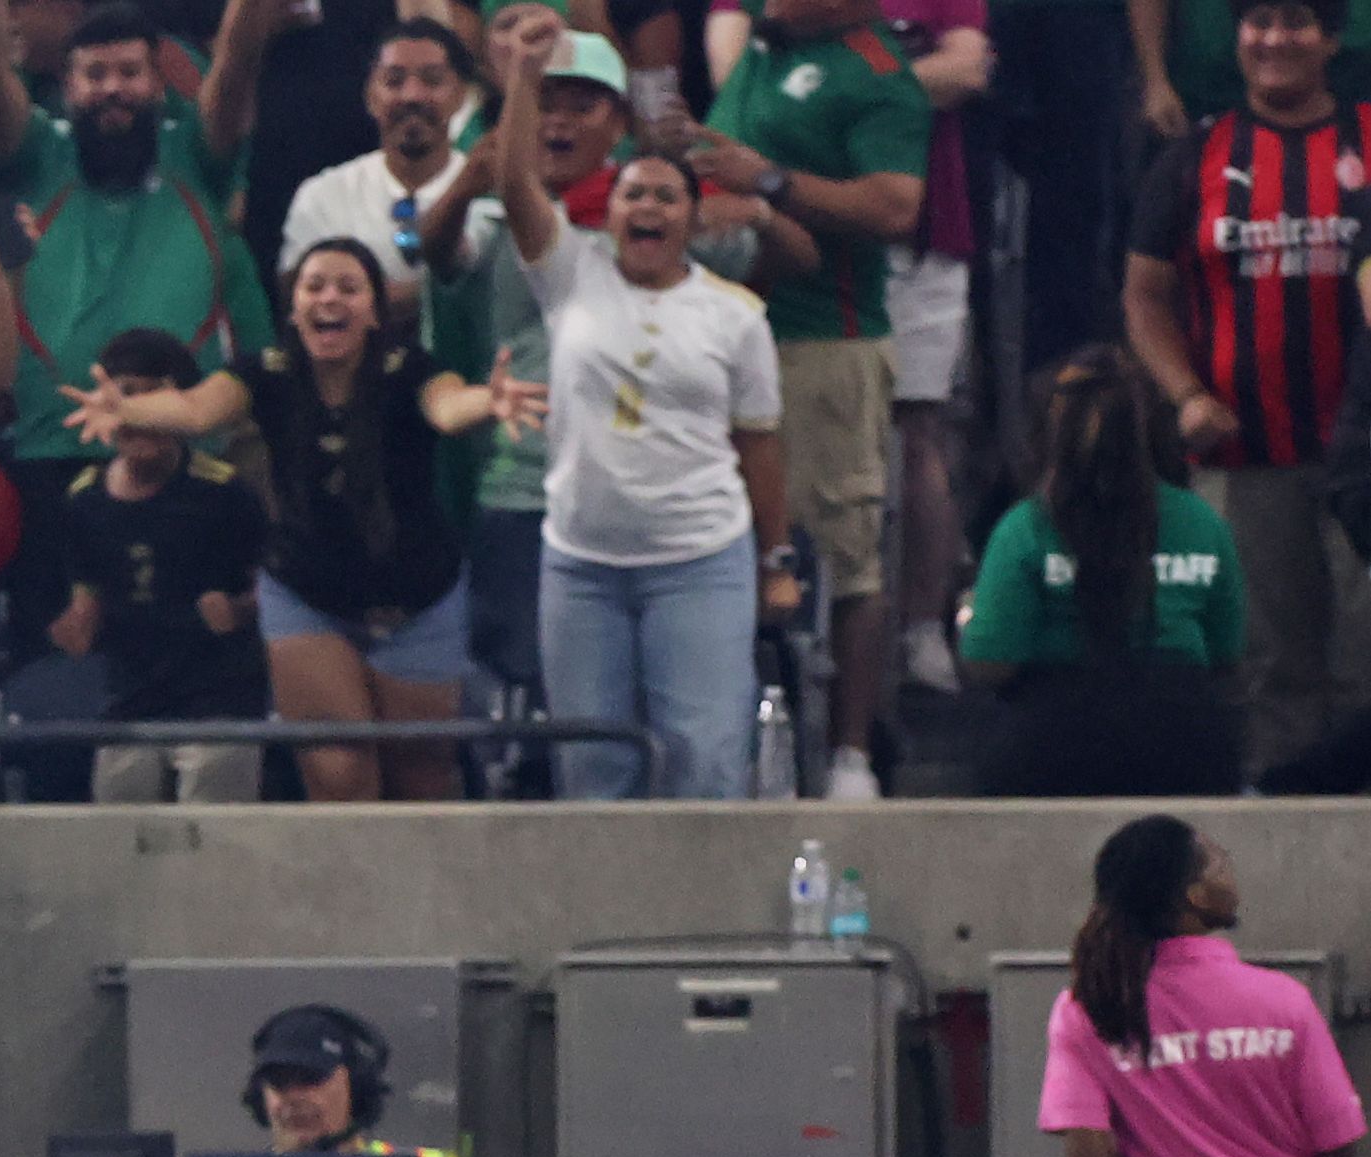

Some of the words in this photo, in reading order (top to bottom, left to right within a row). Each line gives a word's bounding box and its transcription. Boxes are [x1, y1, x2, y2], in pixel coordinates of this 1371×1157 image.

[1151, 553, 1219, 586] TAFF
[1109, 1031, 1199, 1072] ENT
[1206, 1027, 1294, 1061] STAFF
